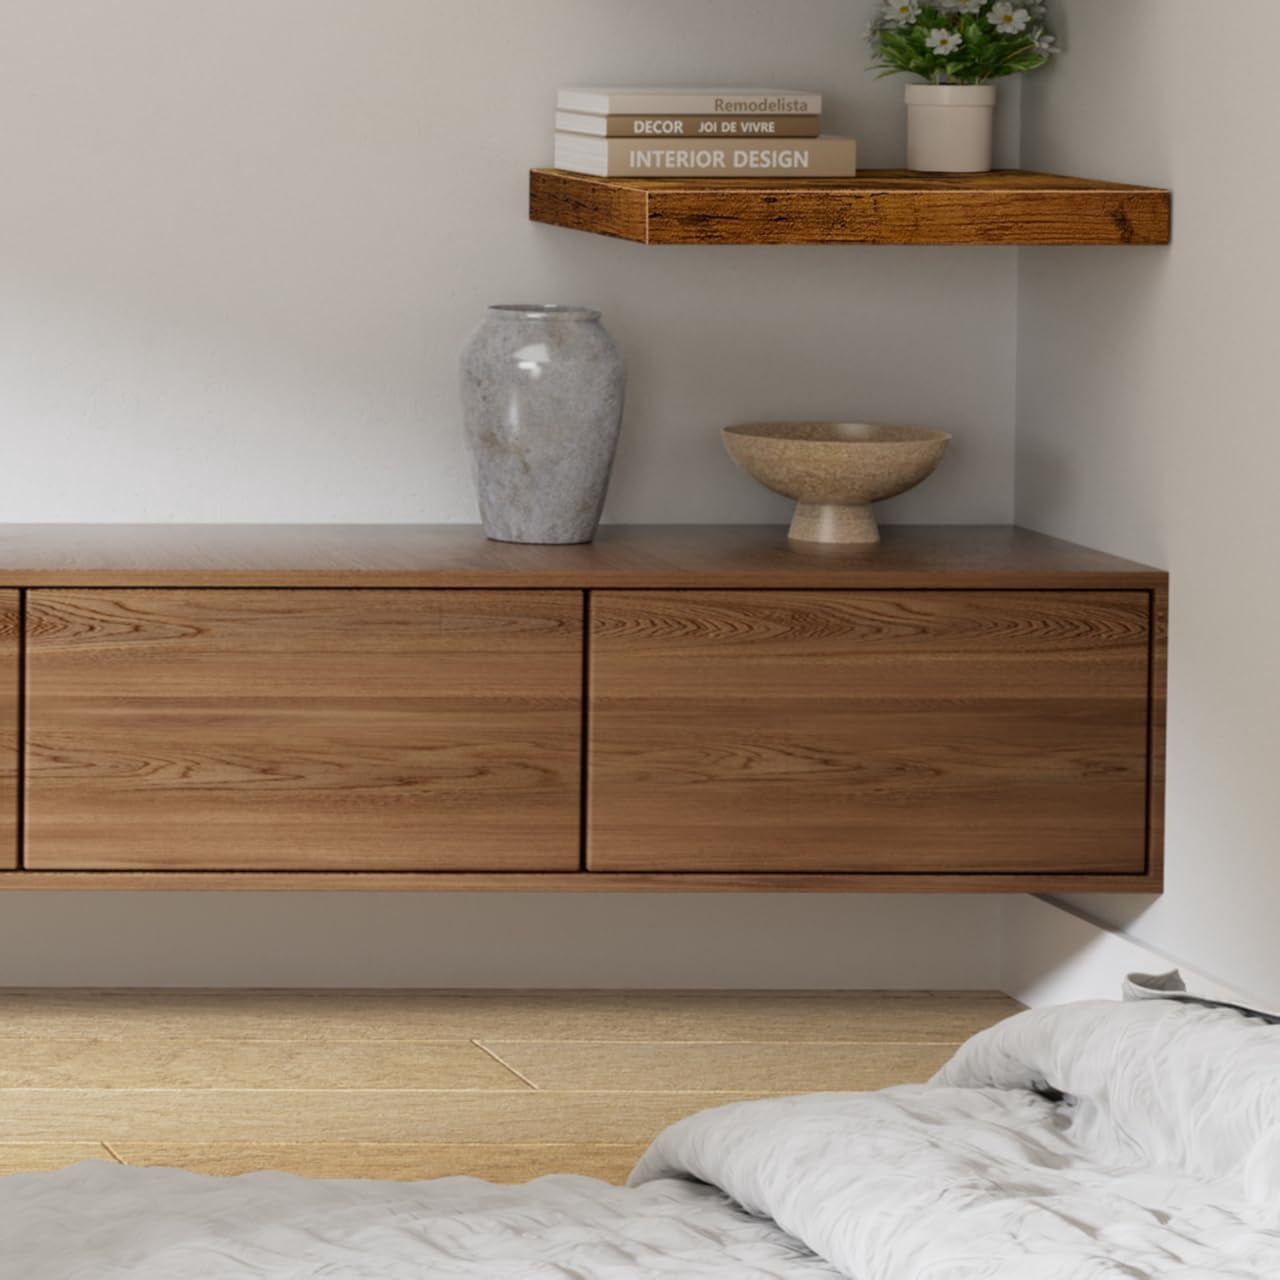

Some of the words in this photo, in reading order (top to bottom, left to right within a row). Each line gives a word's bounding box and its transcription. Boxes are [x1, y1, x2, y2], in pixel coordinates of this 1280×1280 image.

[714, 98, 808, 113] Remodelista
[633, 120, 684, 134] DECOR
[697, 121, 717, 134] JOI
[721, 121, 737, 133] DE
[740, 121, 776, 133] VIVRE
[629, 150, 726, 169] INTERIOR
[733, 150, 809, 169] DESIGN
